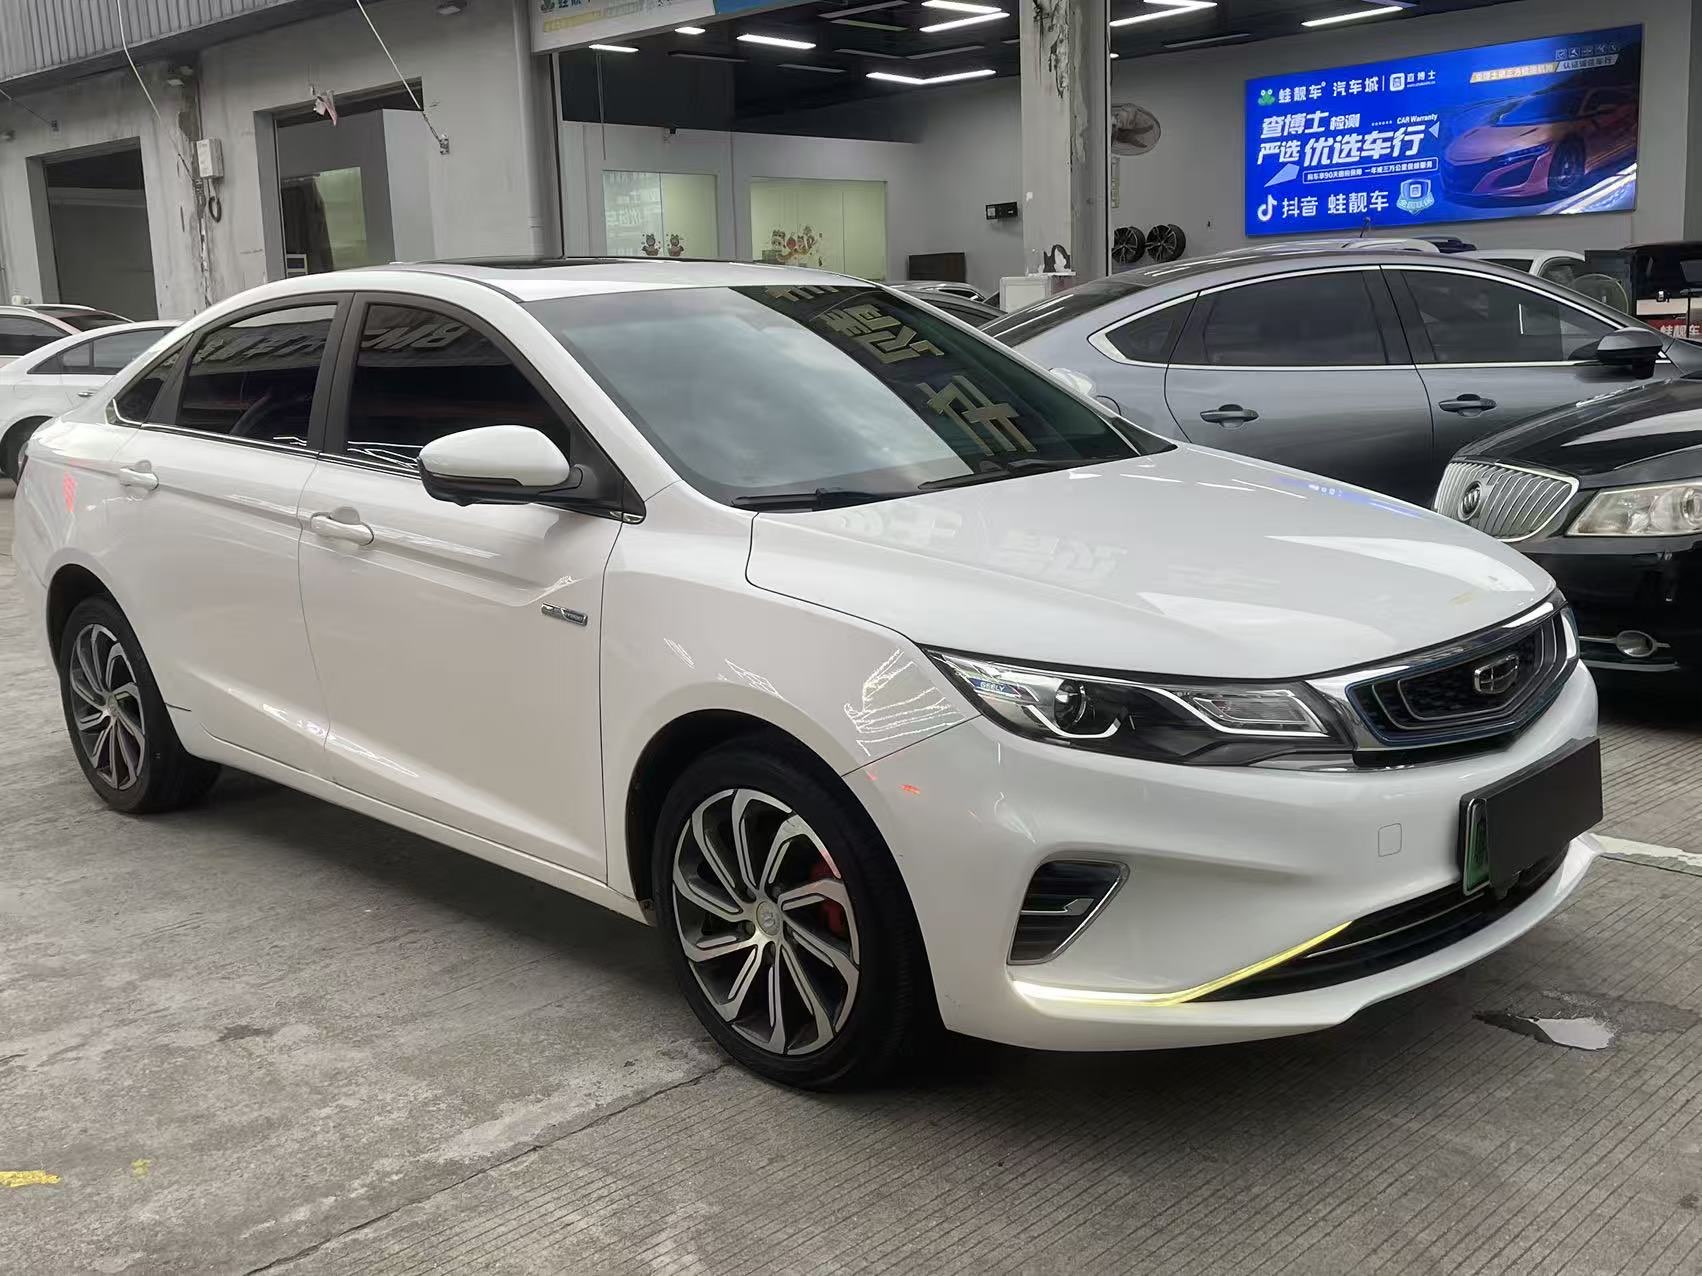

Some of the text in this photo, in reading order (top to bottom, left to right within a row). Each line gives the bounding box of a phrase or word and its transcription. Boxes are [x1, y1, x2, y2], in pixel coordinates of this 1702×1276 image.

[1278, 76, 1379, 104] 蛙靓车 汽车城
[1260, 110, 1361, 139] 查博士 检测
[1396, 113, 1439, 125] CAR Warranty
[1257, 124, 1426, 168] 严选 优选车行
[1282, 195, 1319, 219] 抖音
[1327, 190, 1390, 215] 蛙靓车
